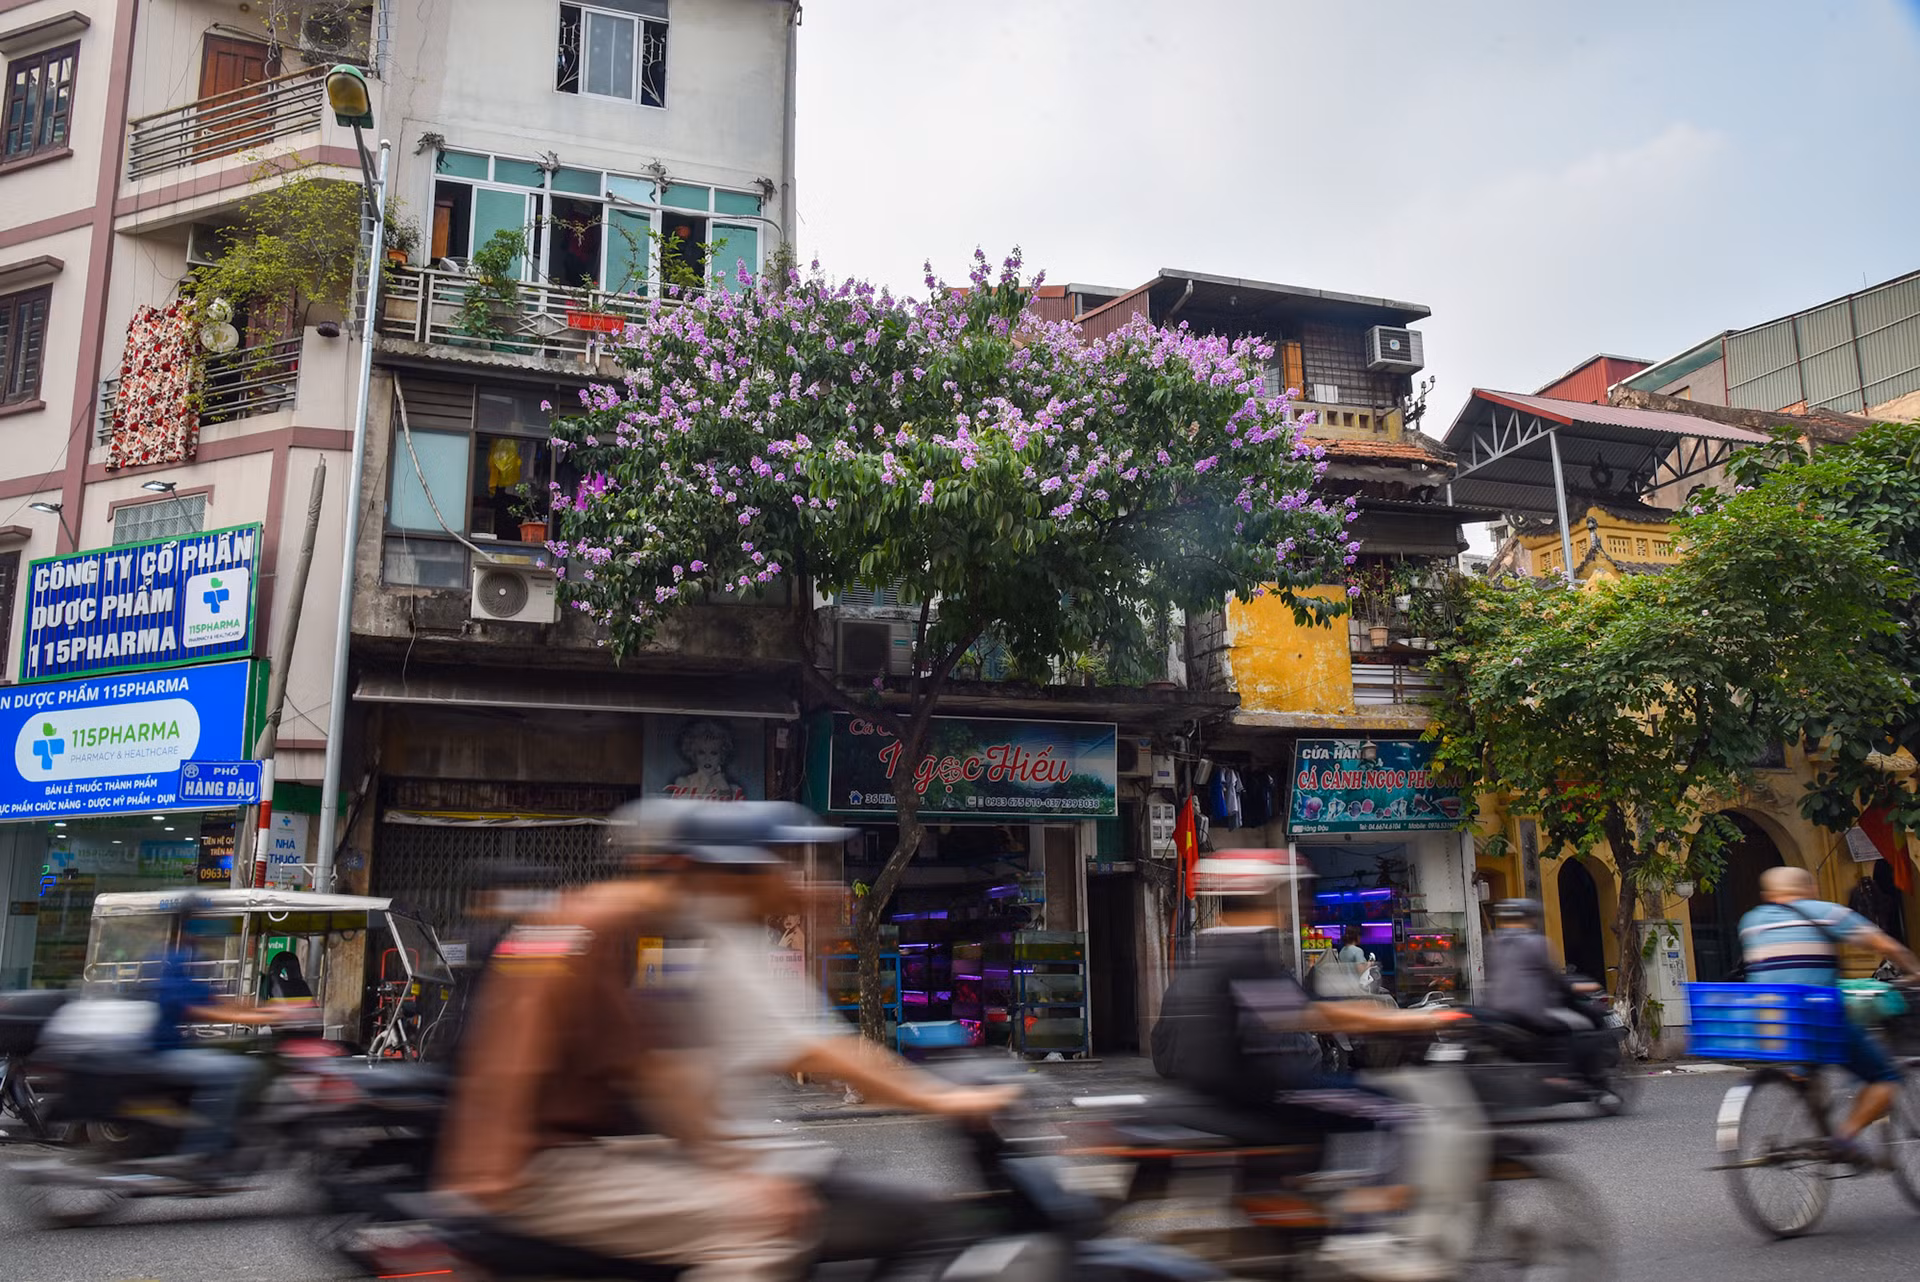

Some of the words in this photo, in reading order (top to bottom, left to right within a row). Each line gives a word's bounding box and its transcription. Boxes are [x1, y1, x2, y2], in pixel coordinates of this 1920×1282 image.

[35, 560, 98, 592] CÔNG
[105, 555, 133, 581] TY
[141, 540, 177, 576] CỔ
[182, 531, 252, 571] PHẦN
[32, 596, 96, 631] DƯỢC
[101, 577, 175, 620] PHẨM
[188, 618, 240, 634] 115PHARMA
[30, 626, 176, 668] 115PHARMA
[14, 691, 55, 709] DƯỢC
[58, 682, 99, 704] PHẨM
[103, 676, 189, 699] 115PHARMA
[72, 719, 180, 748] 115PHARMA
[70, 751, 115, 763] PHARMACY
[116, 750, 122, 760] &
[124, 745, 179, 759] HEALTHCARE
[1302, 744, 1330, 760] CỬA
[1333, 747, 1361, 760] HÀN
[213, 764, 240, 776] PHỐ
[986, 742, 1073, 783] Hiếu
[45, 783, 62, 795] BÁN
[63, 782, 74, 794] LẺ
[75, 779, 103, 793] THUỐC
[104, 778, 132, 791] THÀNH
[134, 775, 158, 789] PHẨM
[1297, 764, 1319, 790] CÁ
[1321, 763, 1363, 790] CẢNH
[1365, 769, 1406, 794] NGỌC
[184, 778, 224, 796] HÀNG
[226, 778, 255, 800] ĐẬU
[865, 793, 878, 804] 36
[879, 793, 896, 805] Hàn
[35, 800, 57, 812] CHỨC
[58, 798, 81, 810] NĂNG
[88, 796, 112, 810] DƯỢC
[113, 795, 125, 806] MỸ
[157, 794, 176, 806] DỤN
[985, 796, 1007, 807] 0983
[1008, 797, 1025, 807] 675
[201, 868, 231, 879] 0963.9
